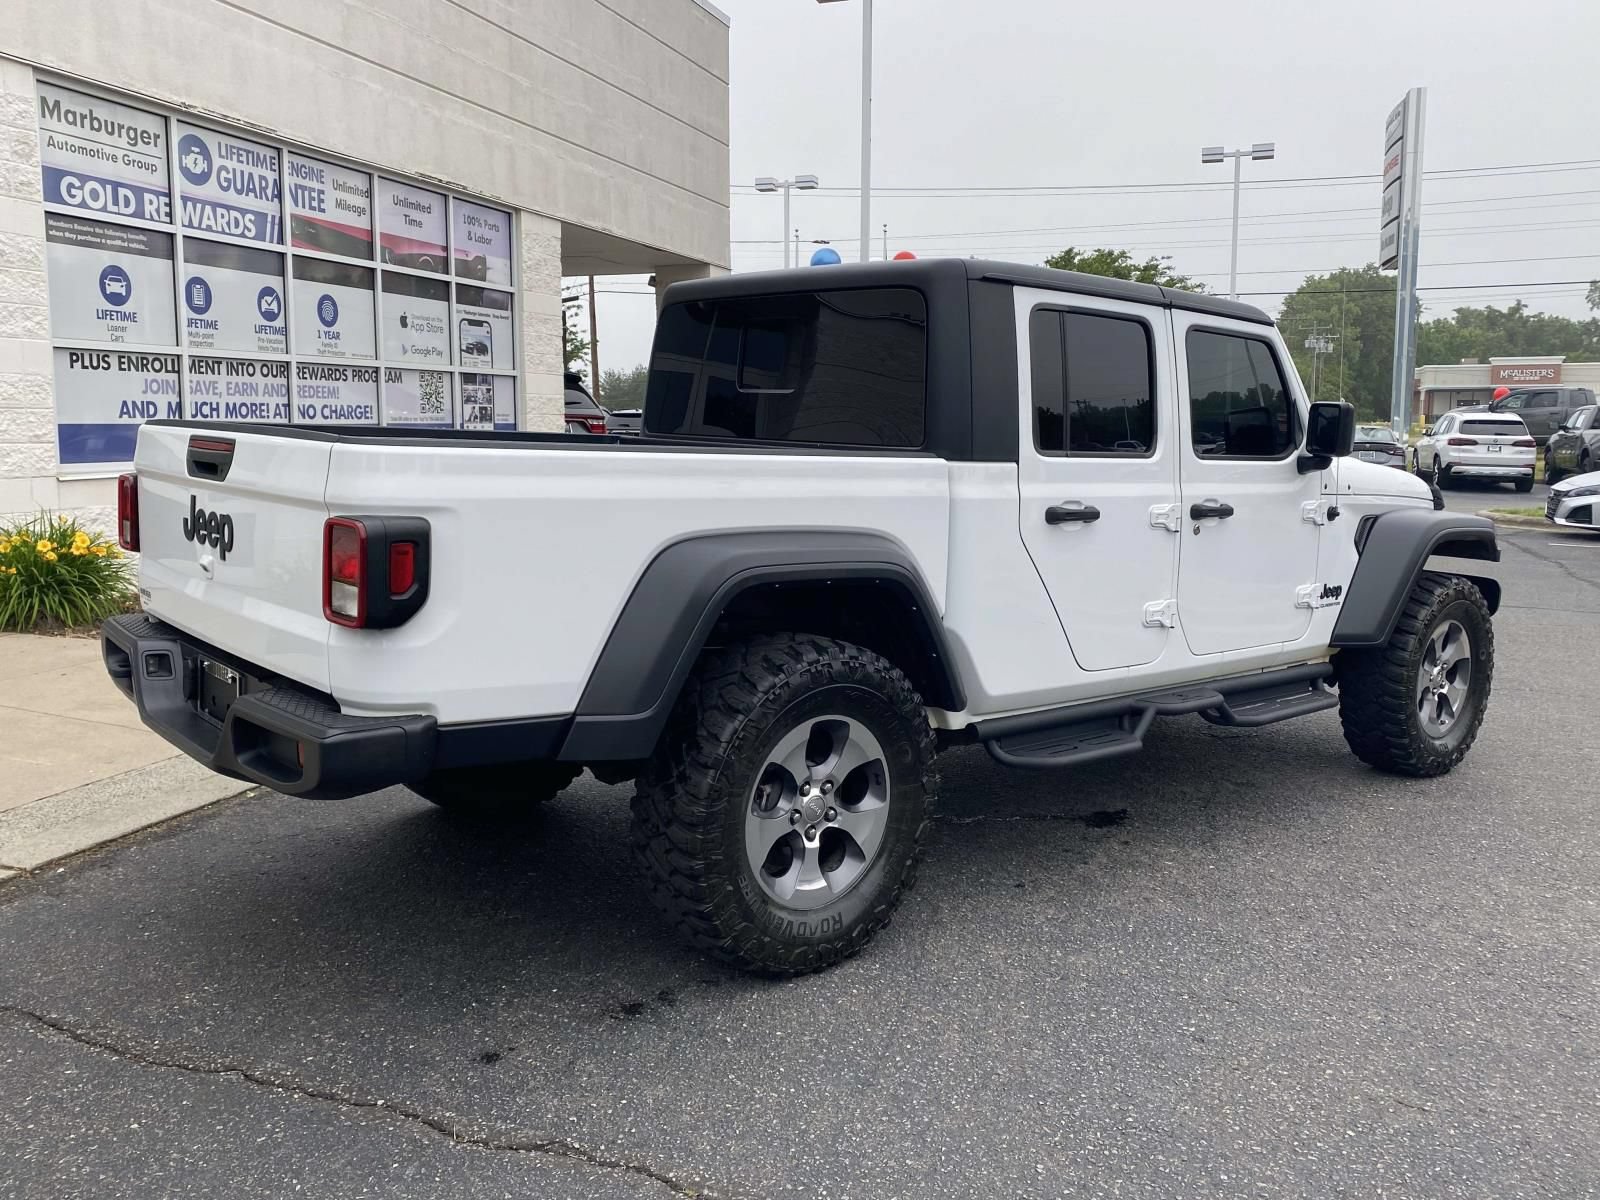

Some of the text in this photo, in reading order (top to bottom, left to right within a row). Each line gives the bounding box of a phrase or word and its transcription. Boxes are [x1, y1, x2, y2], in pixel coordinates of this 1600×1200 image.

[40, 95, 161, 147] Marburger
[47, 135, 158, 175] Automotive Group
[217, 141, 277, 172] LIFETIME
[60, 175, 136, 215] GOLD
[332, 178, 369, 199] Unlimited
[335, 197, 367, 217] Mileage
[392, 194, 432, 214] Unlimited
[403, 213, 423, 229] Time
[463, 214, 500, 233] 100% Parts
[467, 230, 493, 245] & Labor
[96, 308, 138, 323] LIFETIME
[187, 318, 219, 330] IFETIME
[107, 323, 128, 333] Loaner
[254, 324, 286, 336] LIFETIME
[317, 330, 341, 340] 1 YEAR
[411, 320, 444, 334] App Store
[111, 333, 125, 343] Cars
[411, 345, 443, 358] Google Play
[69, 352, 111, 370] PLUS
[226, 360, 256, 377] INTO
[260, 363, 287, 379] OUR
[296, 366, 348, 382] REWARDS
[142, 378, 179, 398] JOIN,
[226, 381, 258, 397] EARN
[262, 382, 287, 397] AND
[297, 384, 340, 400] REDEEM!
[119, 400, 158, 419] AND
[225, 402, 270, 419] MORE!
[273, 402, 288, 419] AT
[298, 404, 317, 420] NO
[321, 404, 374, 420] CHARGE!
[183, 495, 234, 561] Jeep
[1320, 584, 1342, 600] Jeep
